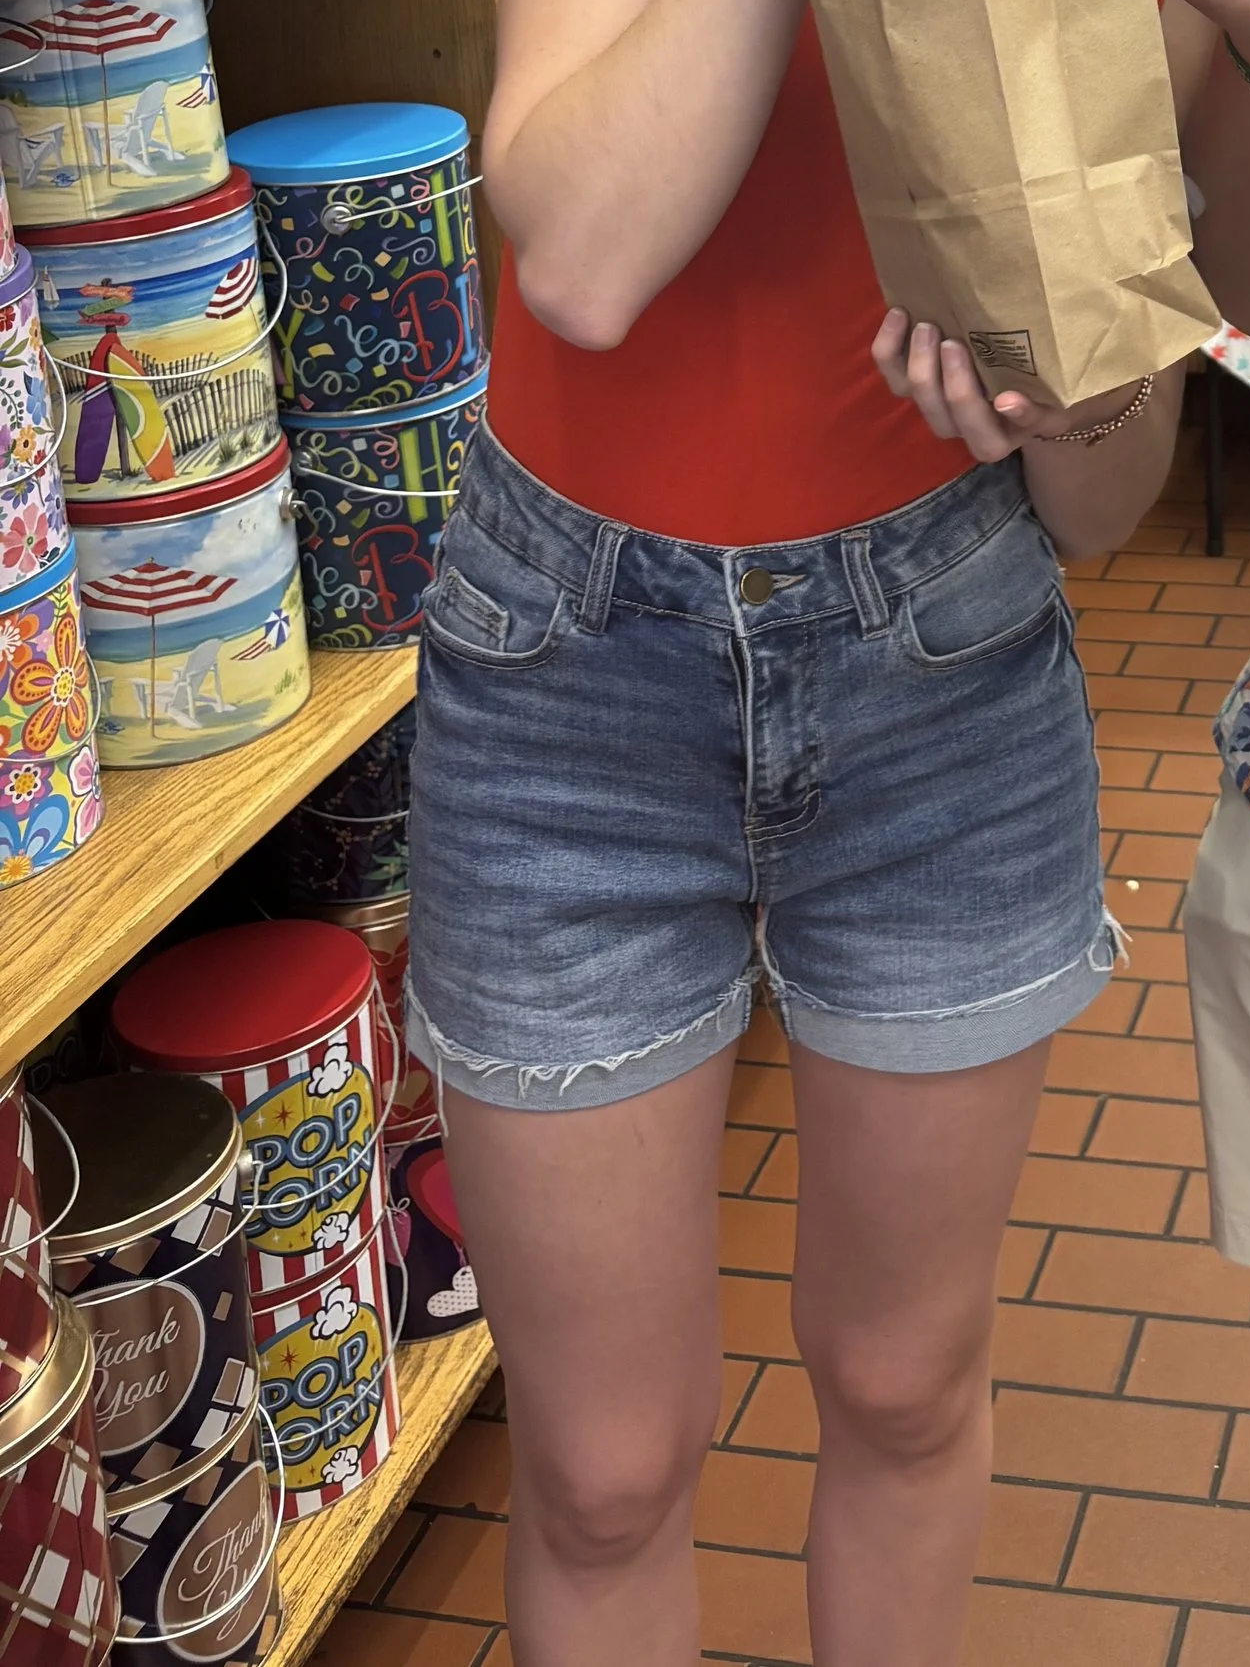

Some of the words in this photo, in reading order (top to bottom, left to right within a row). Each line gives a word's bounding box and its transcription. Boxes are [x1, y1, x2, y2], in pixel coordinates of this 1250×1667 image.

[249, 1092, 361, 1185] POP
[260, 1330, 369, 1420] POP
[265, 1362, 383, 1471] ORN
